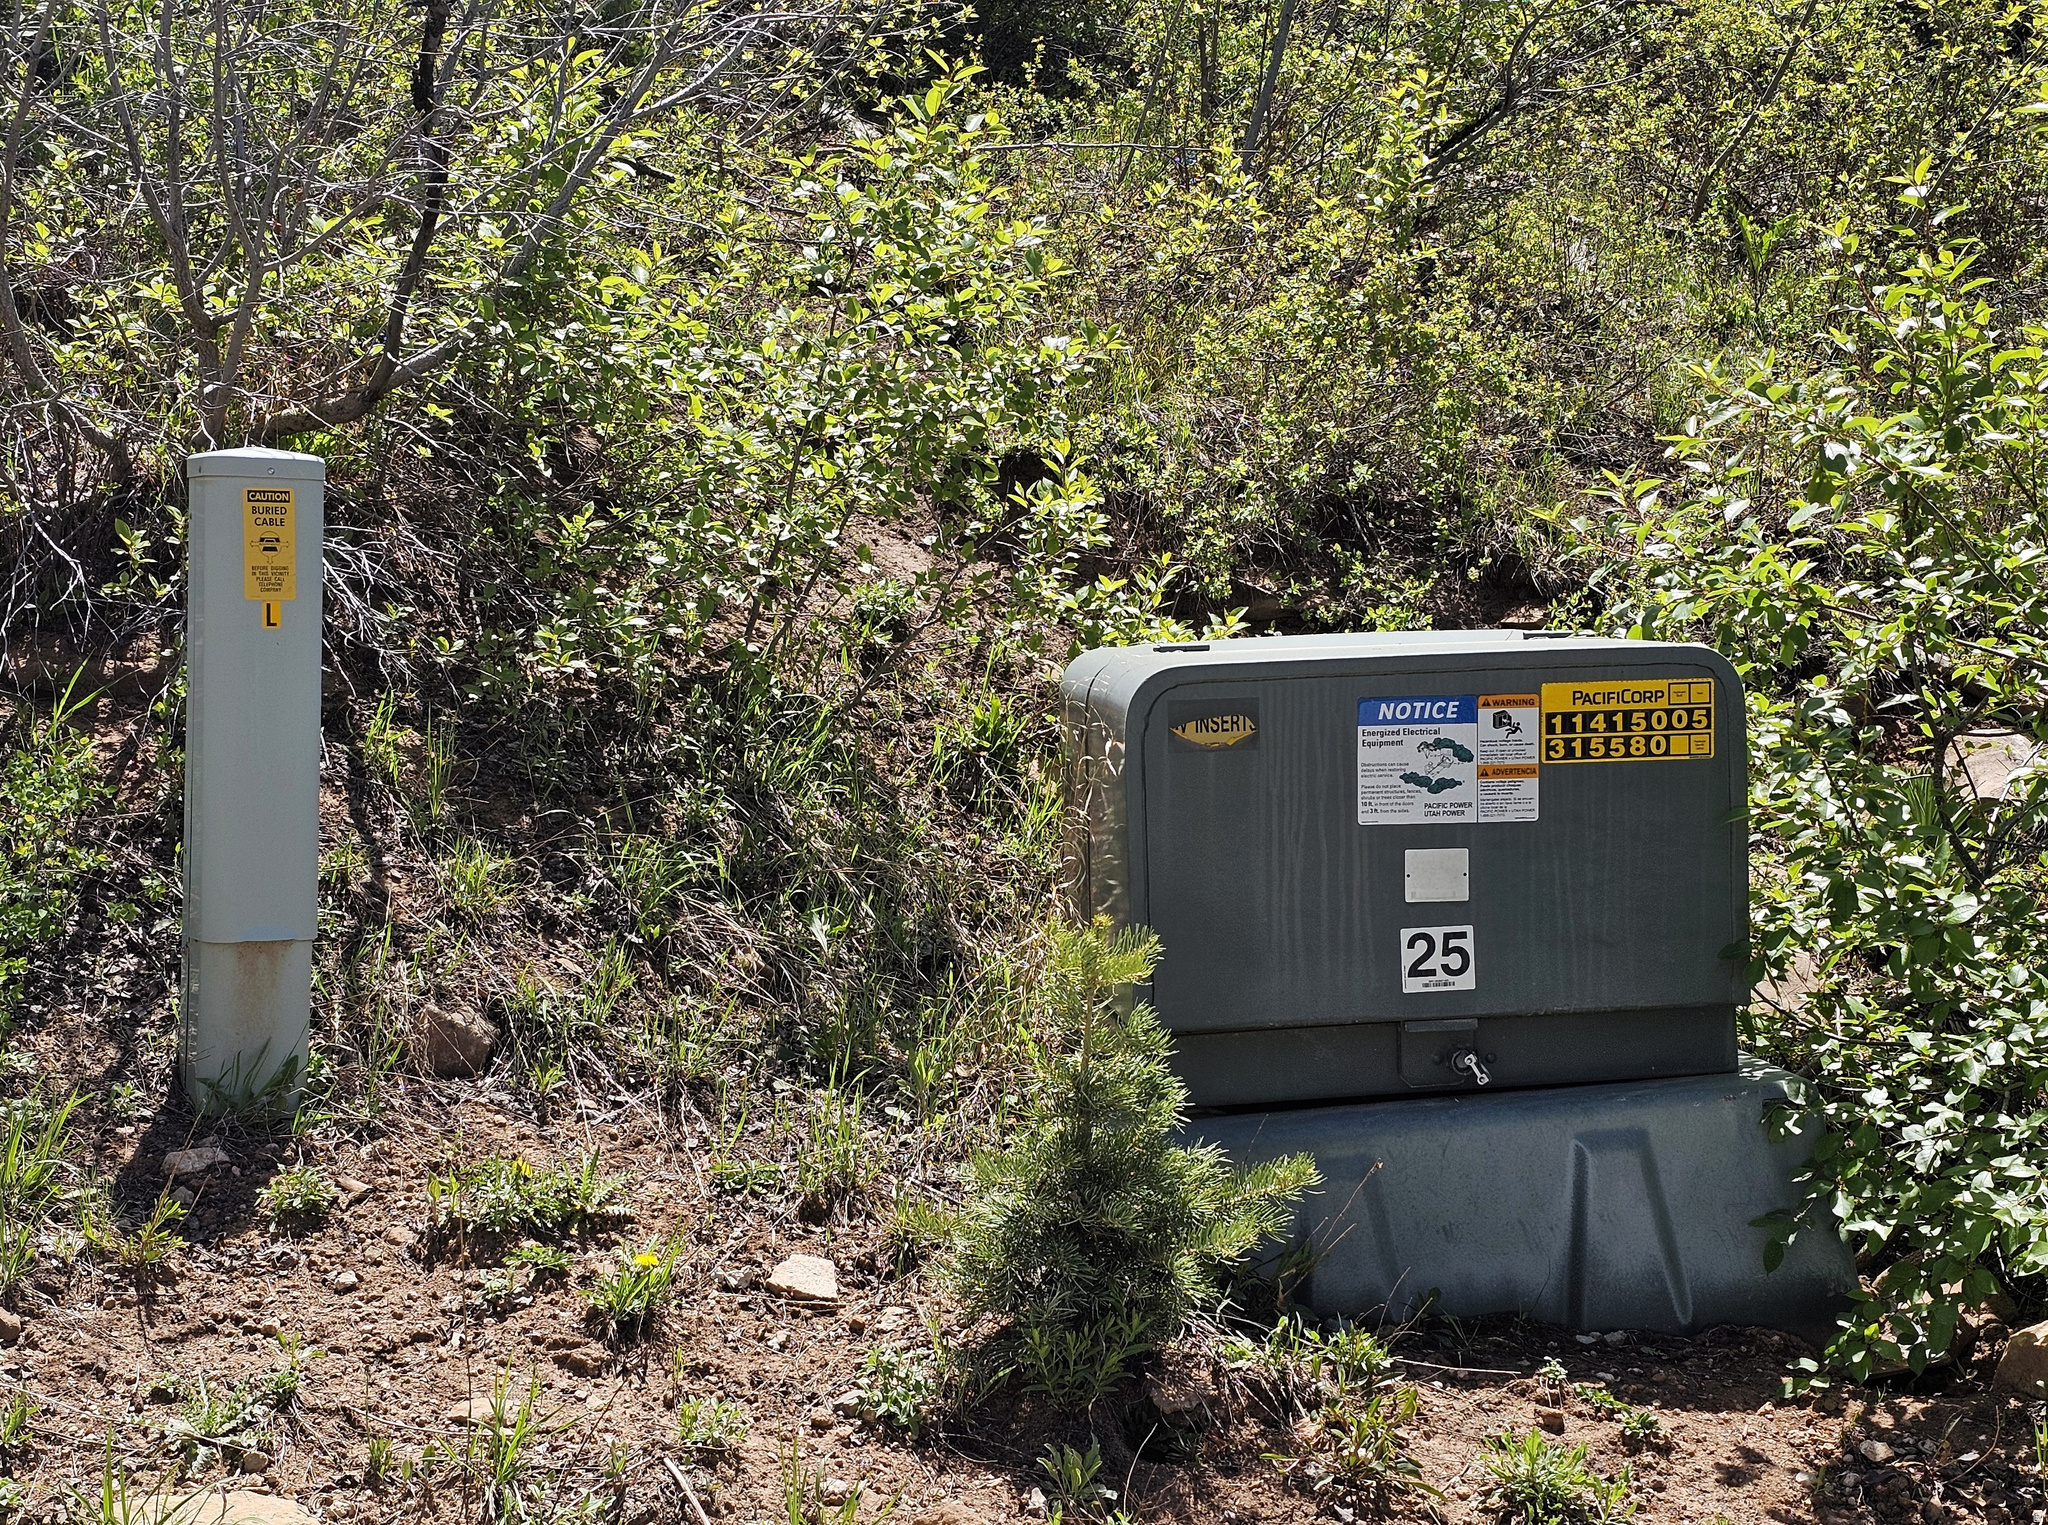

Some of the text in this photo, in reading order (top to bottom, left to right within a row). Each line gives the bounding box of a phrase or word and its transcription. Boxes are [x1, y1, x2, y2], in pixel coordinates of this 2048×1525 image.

[248, 491, 289, 502] CAUTION
[251, 505, 287, 515] BURIED
[254, 517, 286, 527] CABLE
[266, 603, 277, 627] L
[1492, 698, 1535, 707] WARNING
[1378, 701, 1460, 720] NOTICE
[1551, 709, 1708, 734] 11415005
[1361, 727, 1441, 738] Energized Electrical
[1361, 739, 1404, 749] Equipment
[1548, 735, 1667, 759] 315580
[1491, 767, 1537, 776] ADVERTENCIA
[1423, 802, 1449, 810] PACIFIC
[1441, 809, 1466, 817] POWER
[1406, 931, 1471, 978] 25
